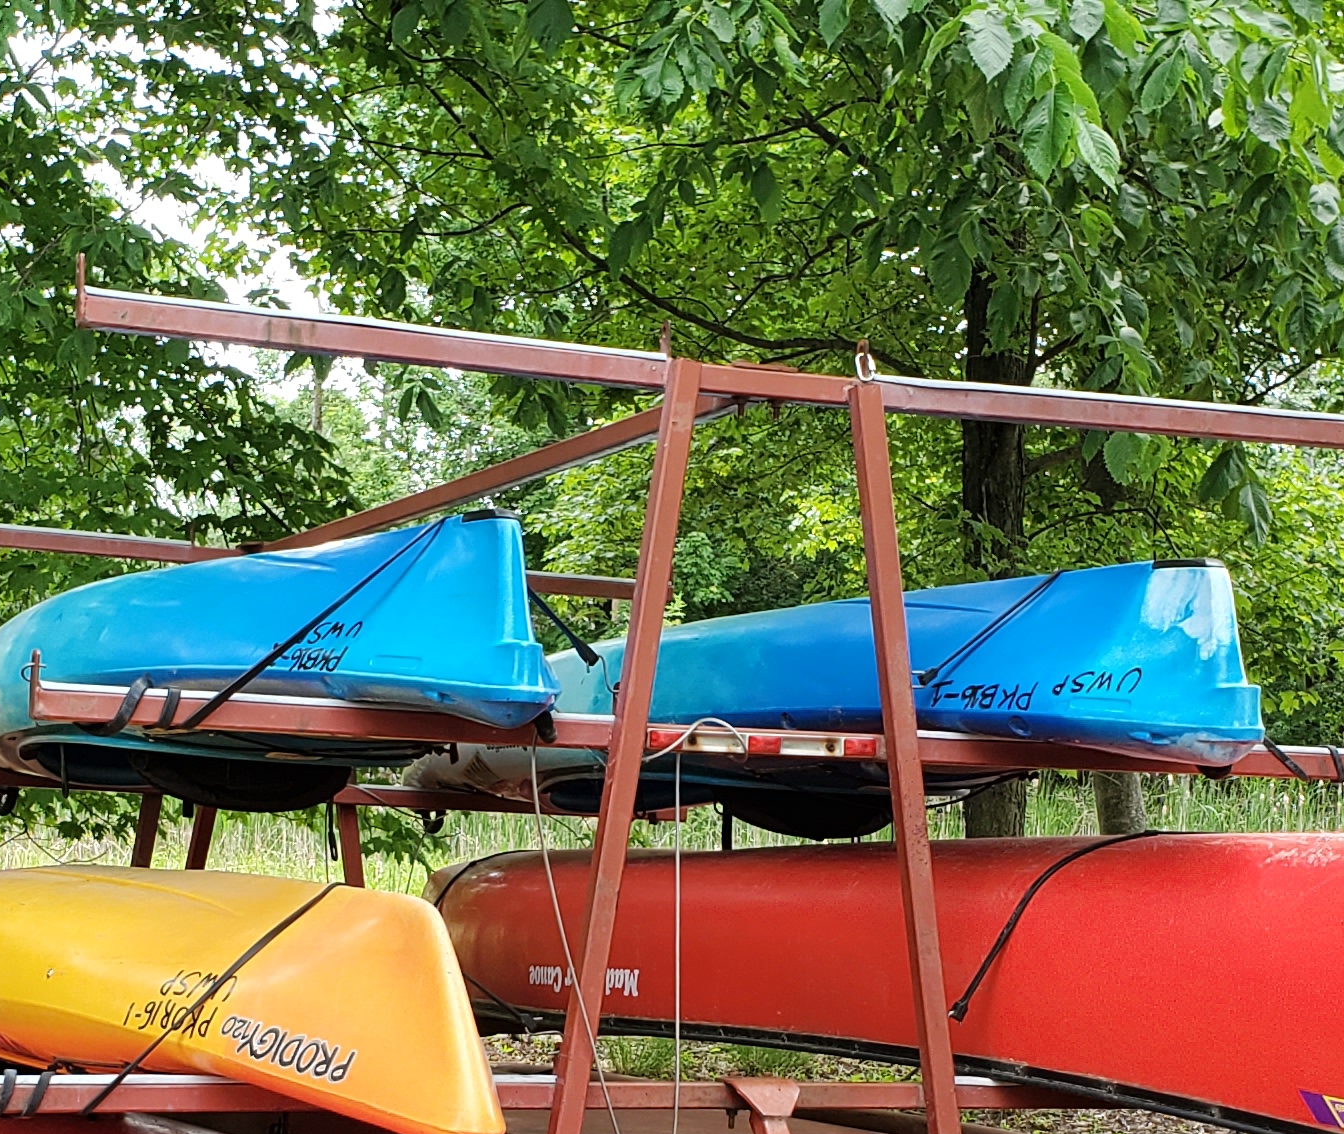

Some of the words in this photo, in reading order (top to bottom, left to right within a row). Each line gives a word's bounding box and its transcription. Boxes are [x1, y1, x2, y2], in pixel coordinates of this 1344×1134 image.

[295, 621, 363, 645] UWS
[1052, 667, 1142, 697] UWSP
[528, 964, 563, 993] Canoe
[605, 967, 640, 997] Mad
